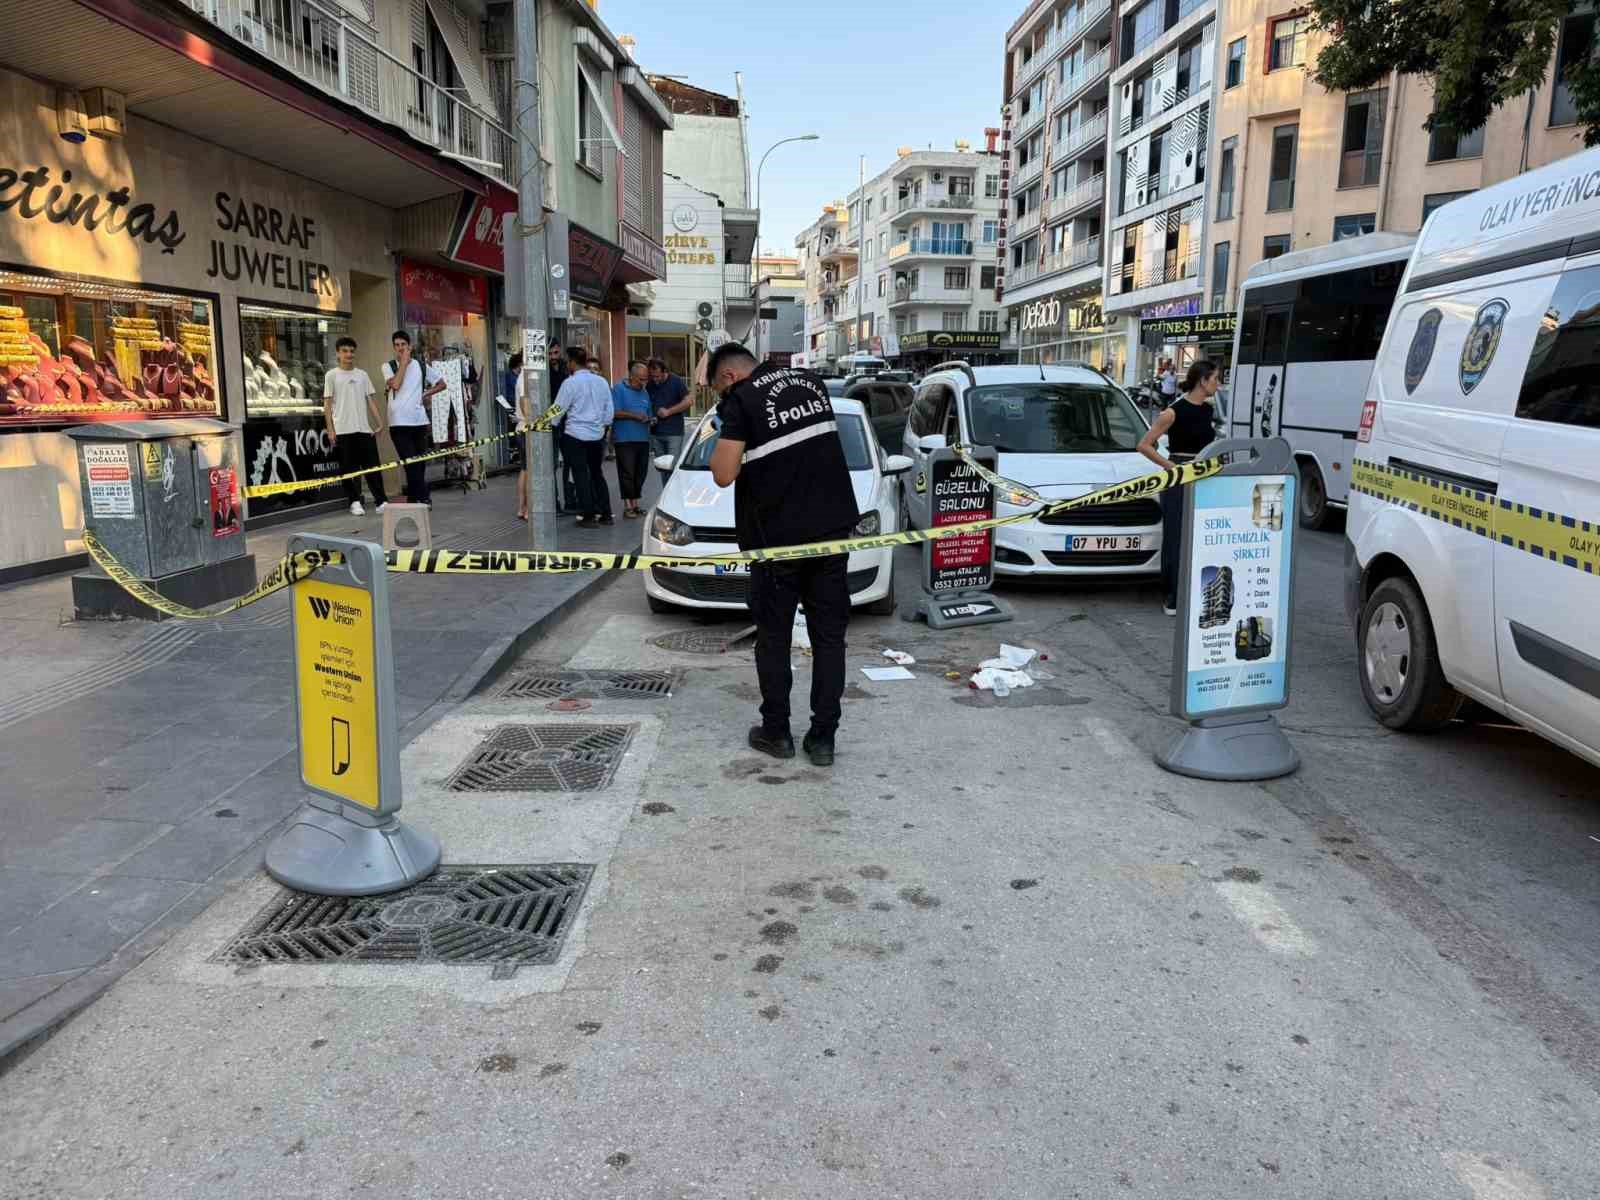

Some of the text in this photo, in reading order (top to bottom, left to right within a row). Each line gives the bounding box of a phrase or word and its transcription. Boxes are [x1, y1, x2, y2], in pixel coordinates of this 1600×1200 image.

[215, 192, 315, 250] SARRAF
[1480, 195, 1524, 231] OLAY
[207, 240, 332, 297] JUWELIER
[1022, 297, 1060, 330] DeFacto
[766, 399, 778, 428] OLAY
[778, 399, 823, 424] POLİS
[935, 480, 990, 496] GÜZELLİK
[939, 497, 985, 512] SALONU
[1432, 494, 1445, 506] OLAY
[1204, 516, 1232, 529] SERİK
[1073, 536, 1139, 549] 07 YPU 36
[1225, 529, 1270, 544] TEMİZLİK
[1569, 536, 1592, 552] OLAY
[1232, 546, 1270, 562] ŞİRKETİ
[332, 600, 362, 617] Western
[333, 610, 354, 625] Union
[313, 662, 362, 682] Western Union
